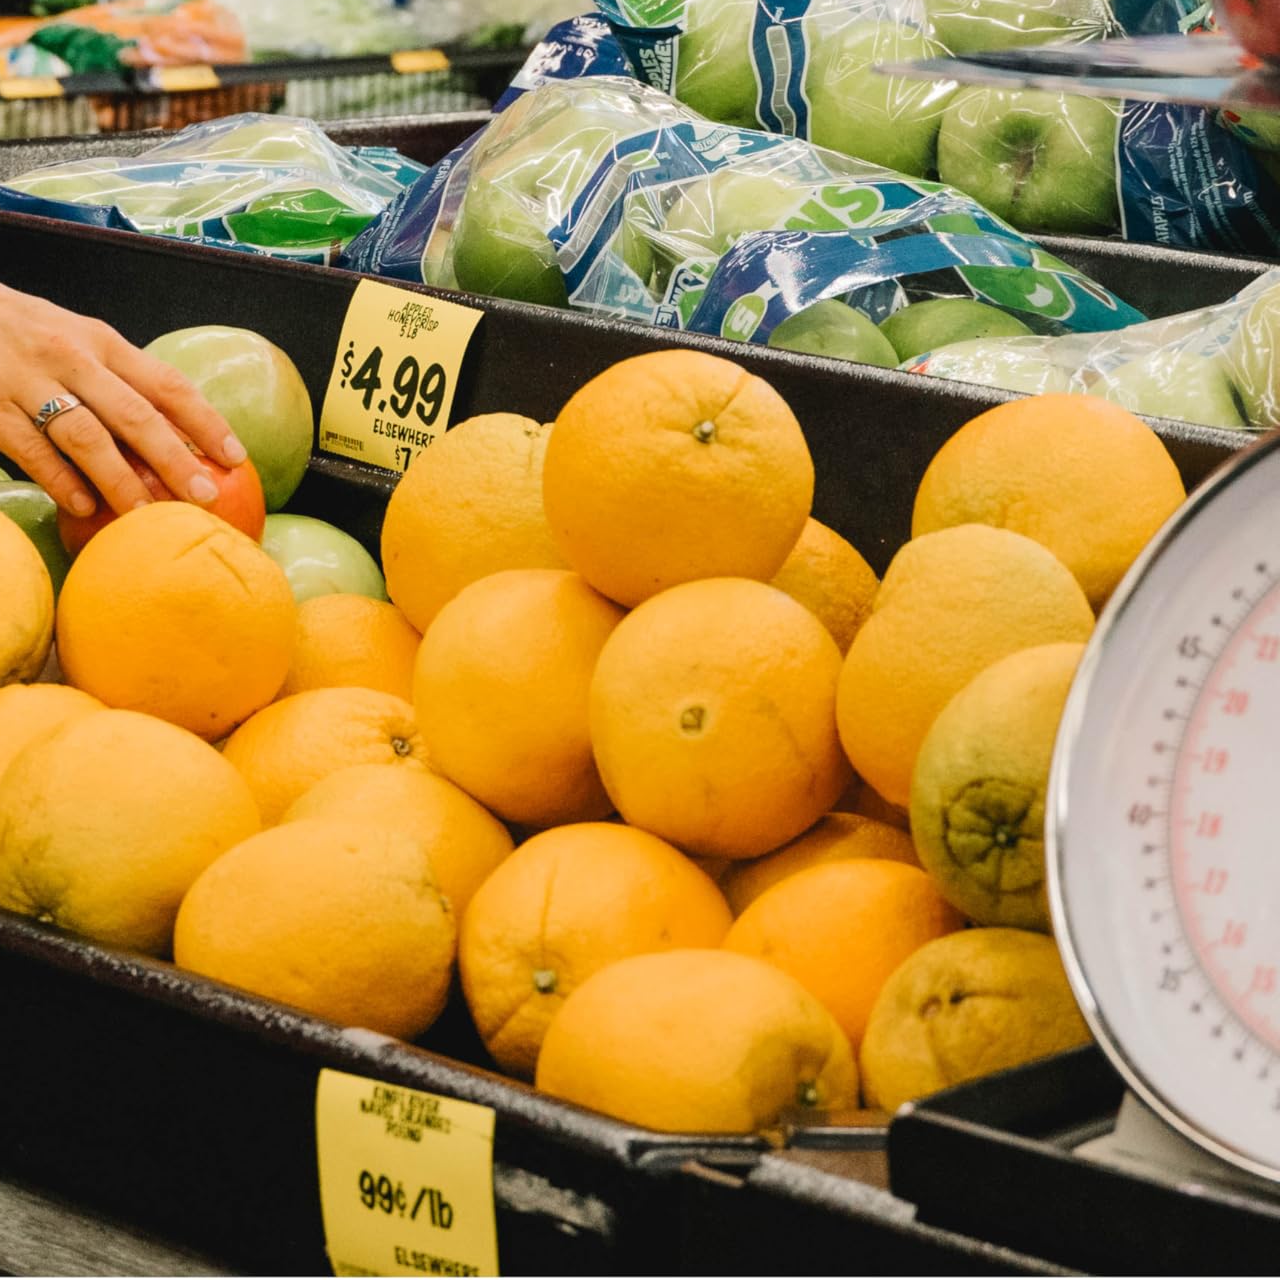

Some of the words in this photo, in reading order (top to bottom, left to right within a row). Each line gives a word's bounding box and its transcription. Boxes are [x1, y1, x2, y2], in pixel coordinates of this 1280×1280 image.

[638, 48, 664, 94] PPLES
[1191, 136, 1199, 148] 125
[388, 311, 439, 332] HONEYCRISP
[403, 302, 434, 318] APPLES
[400, 324, 407, 338] 5
[407, 326, 418, 340] LB
[341, 340, 447, 426] $4.99
[1201, 867, 1229, 895] 17
[359, 1170, 453, 1230] 99¢/lb
